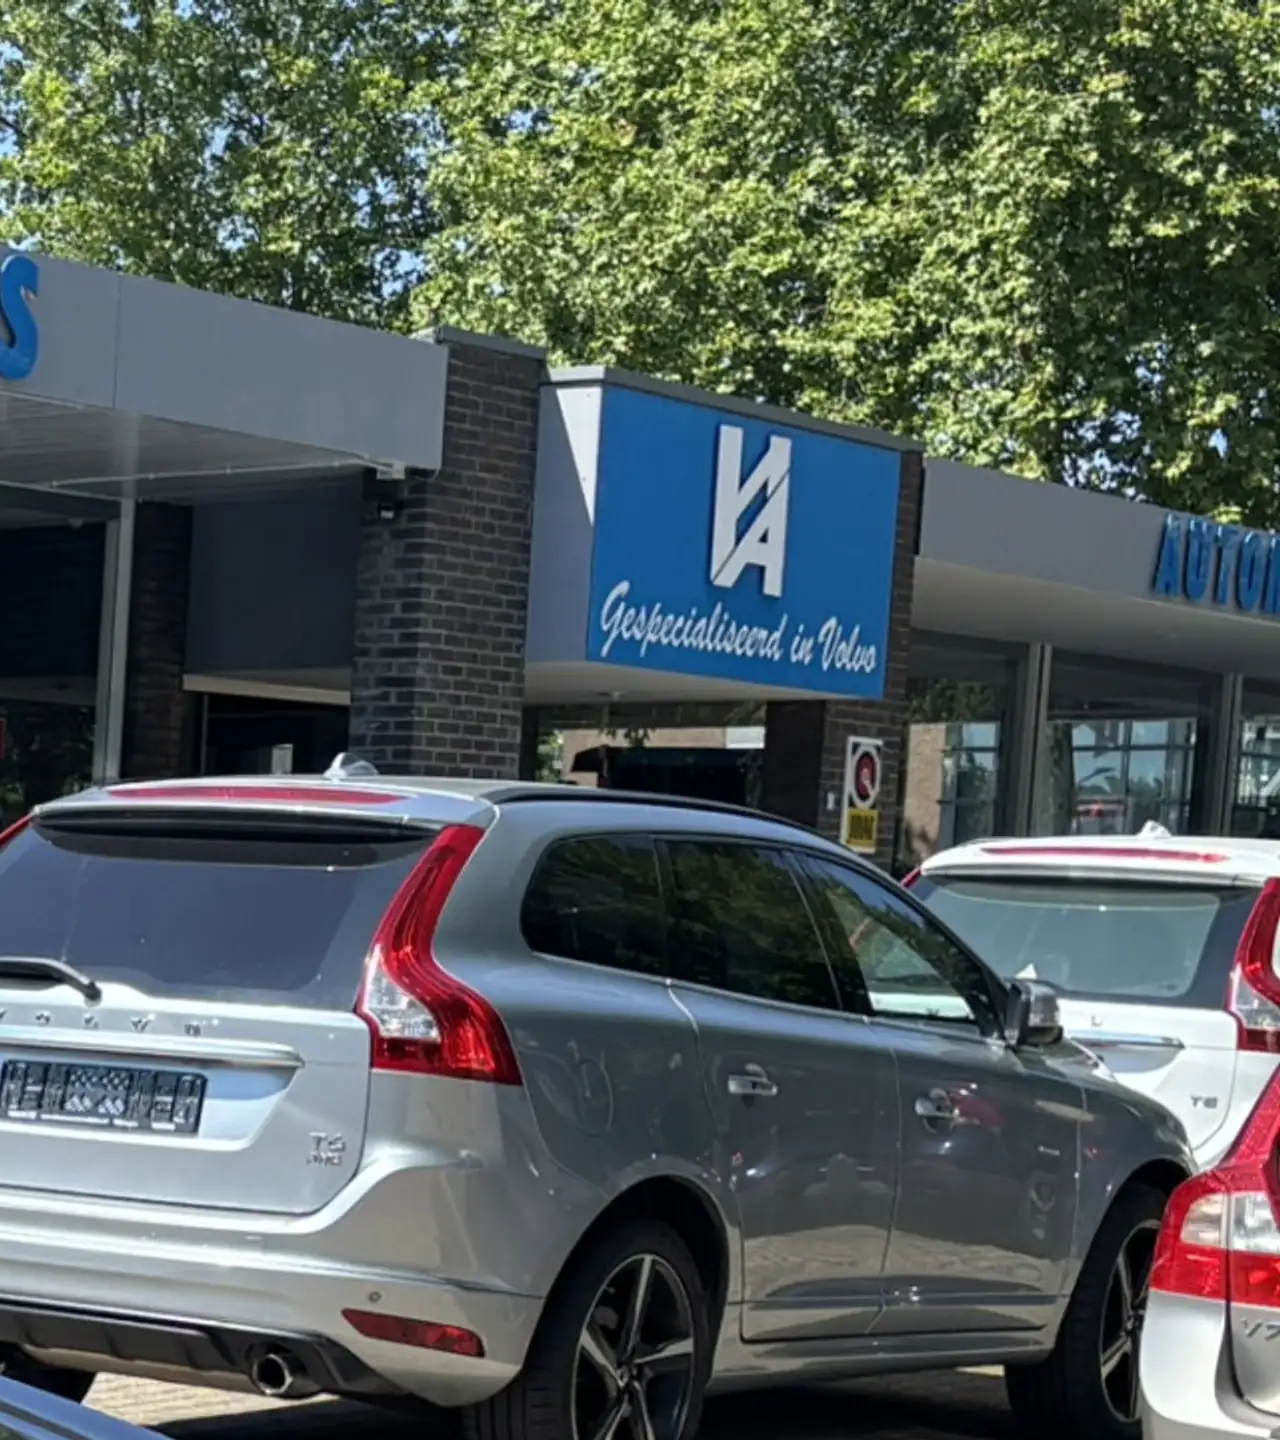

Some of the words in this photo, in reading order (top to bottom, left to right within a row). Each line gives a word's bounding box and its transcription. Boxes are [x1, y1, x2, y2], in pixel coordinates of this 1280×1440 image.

[600, 580, 788, 658] Gespecialiseerd
[790, 624, 814, 665] in
[818, 616, 878, 673] Volvo
